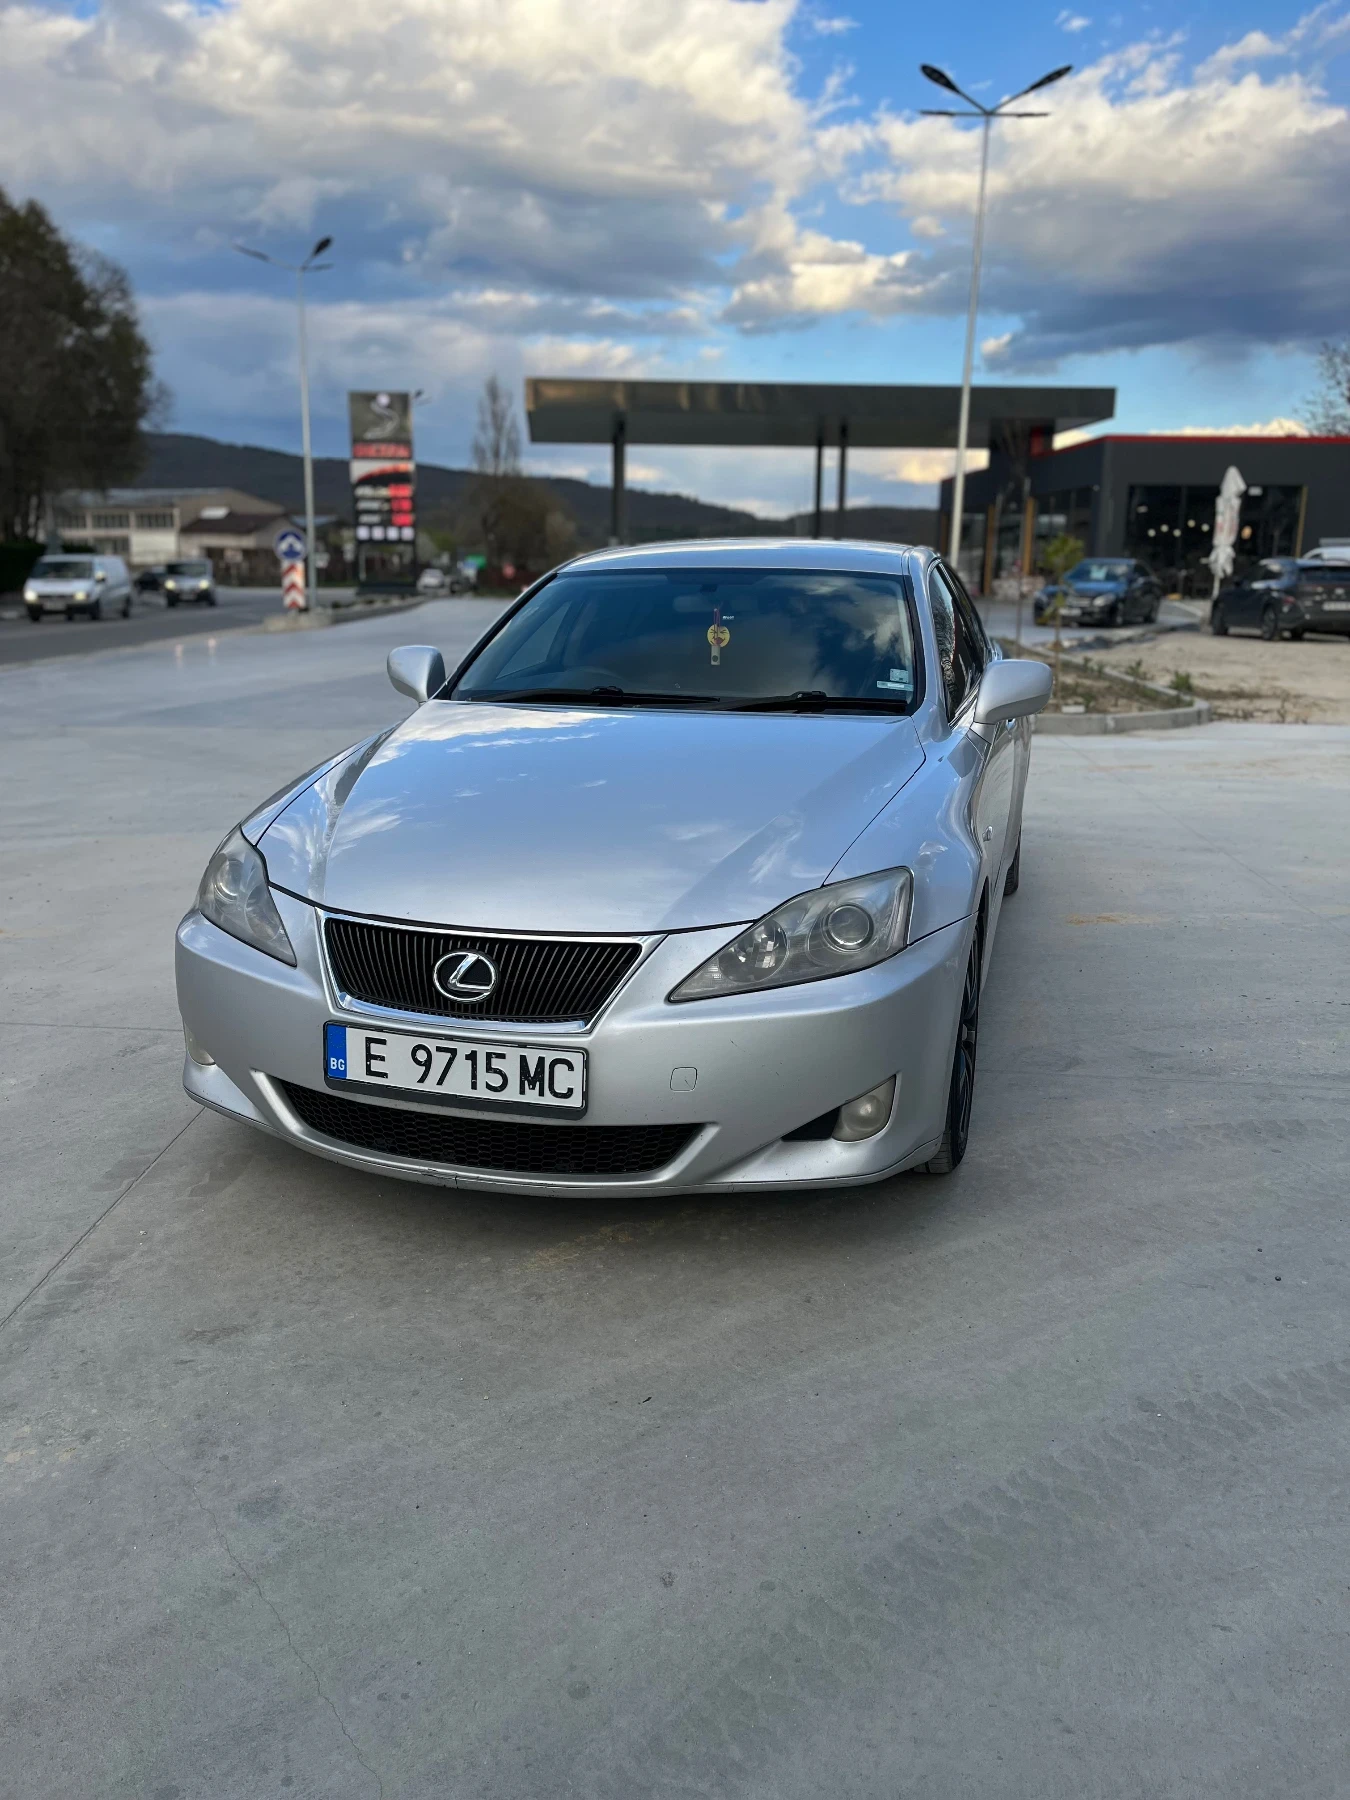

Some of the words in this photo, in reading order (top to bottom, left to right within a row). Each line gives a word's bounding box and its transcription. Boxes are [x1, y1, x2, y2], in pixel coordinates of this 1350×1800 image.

[330, 1057, 345, 1071] BG
[365, 1036, 389, 1079] E
[410, 1043, 509, 1093] 9715
[519, 1054, 575, 1099] MC
